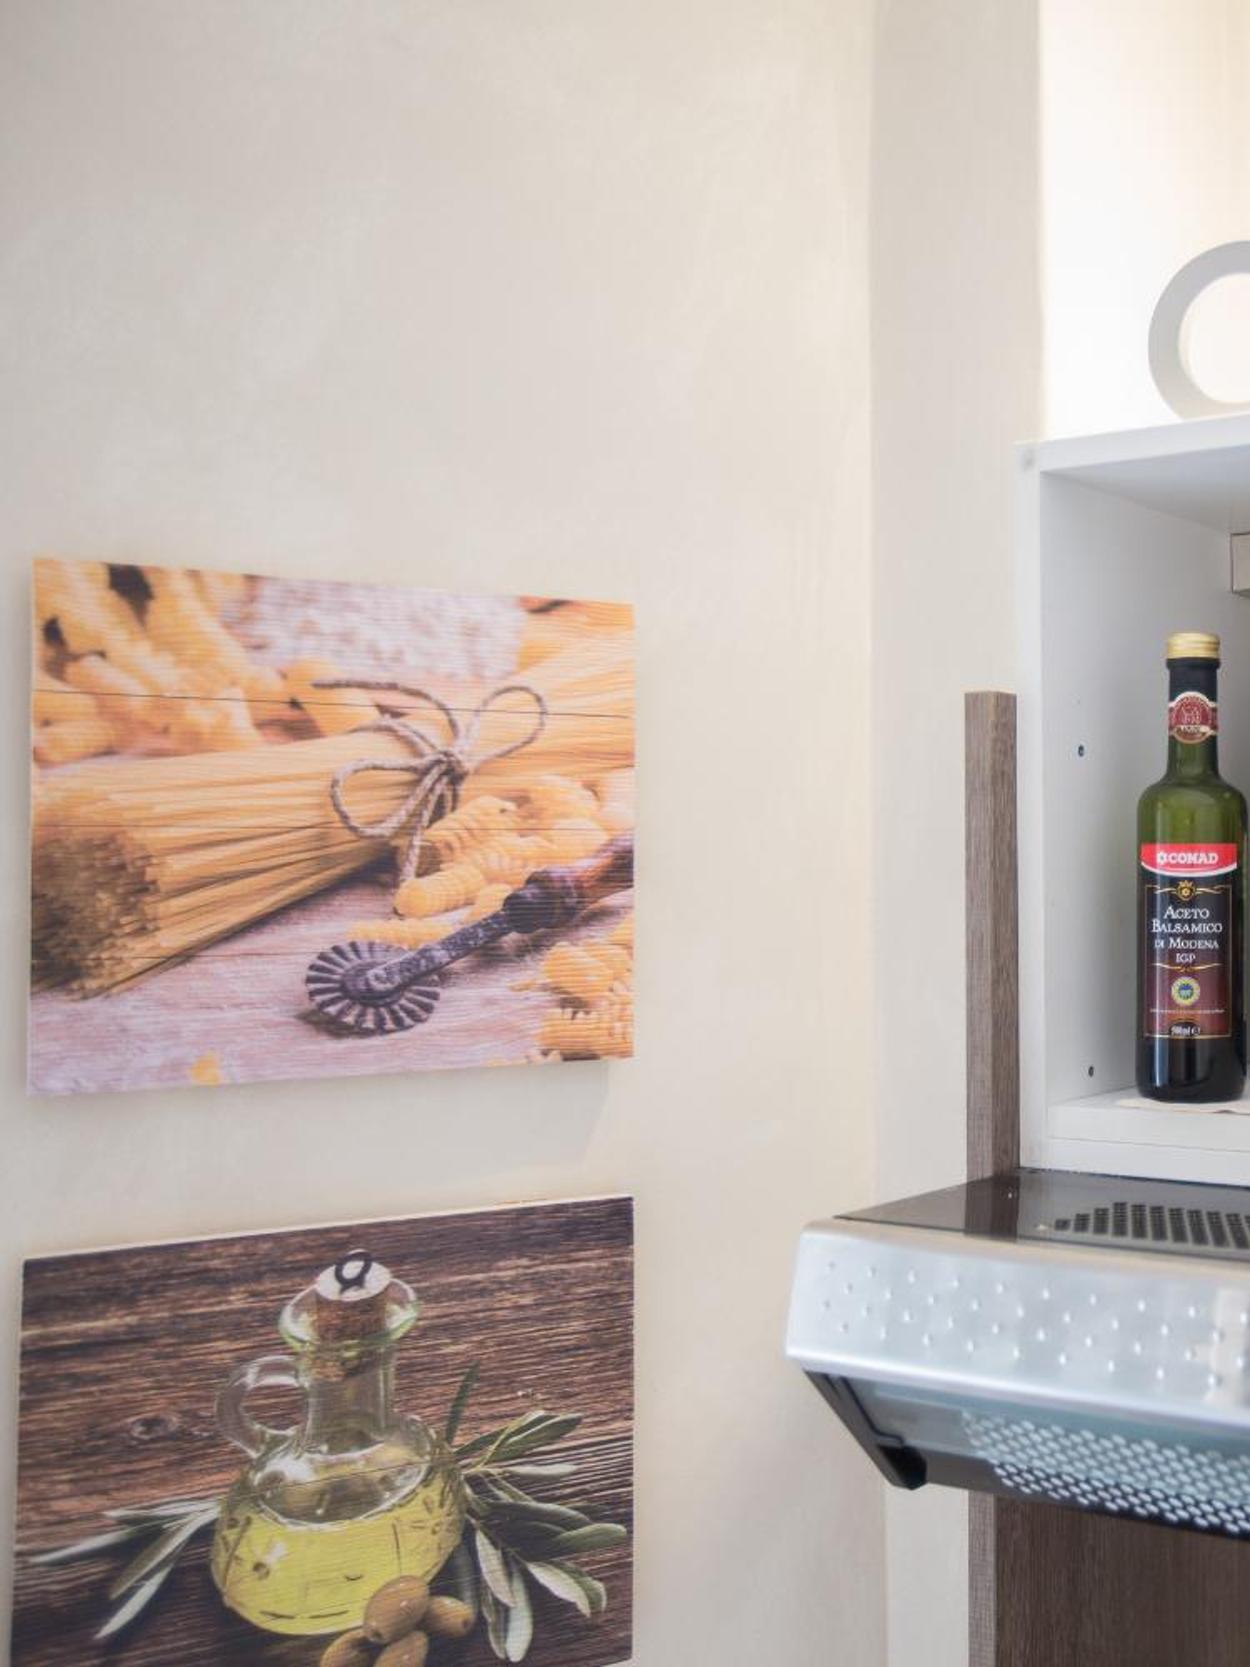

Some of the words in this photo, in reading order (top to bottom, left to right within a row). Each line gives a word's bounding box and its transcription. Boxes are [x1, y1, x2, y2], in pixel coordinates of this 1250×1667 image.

[1163, 905, 1210, 919] ACETO
[1151, 919, 1223, 934] BALSAMICO
[1169, 937, 1219, 950] MODENA
[1175, 953, 1197, 963] IGP
